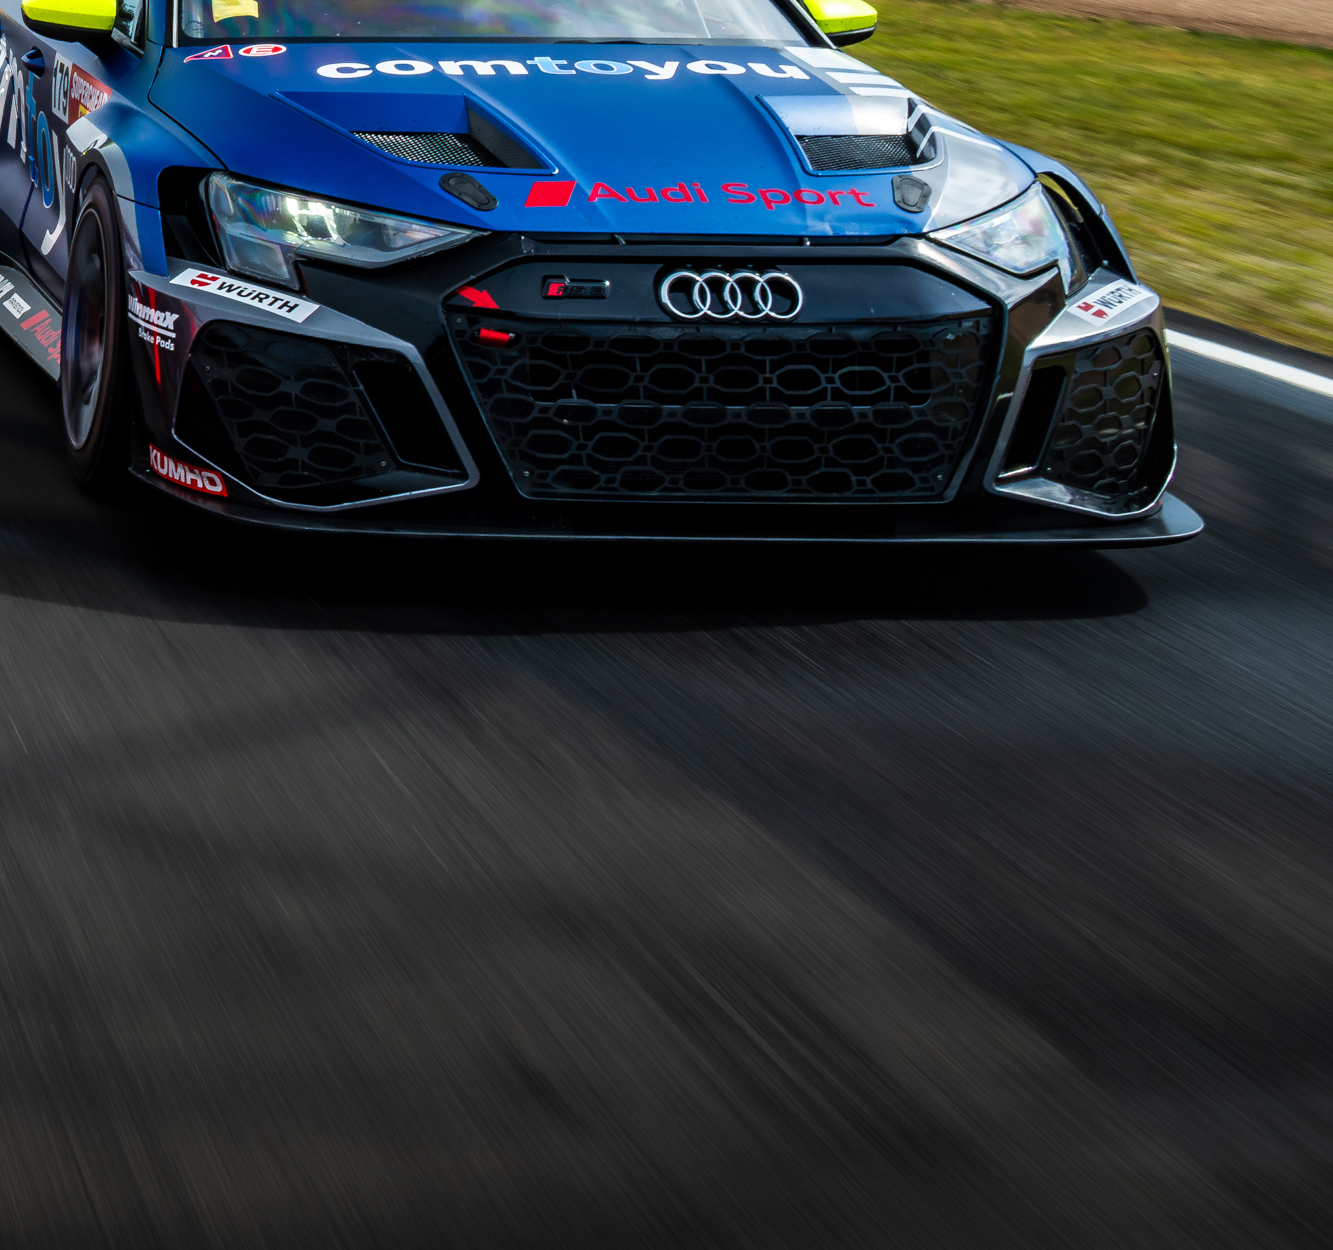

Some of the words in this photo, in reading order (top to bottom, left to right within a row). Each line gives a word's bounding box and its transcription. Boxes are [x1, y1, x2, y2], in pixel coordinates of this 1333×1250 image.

[316, 55, 811, 80] comtoyou
[52, 58, 70, 122] 179
[588, 181, 709, 203] Audi
[721, 182, 876, 210] Sport
[217, 281, 300, 314] WÜRTH
[155, 335, 175, 351] Pads
[149, 444, 223, 494] KUMHO
